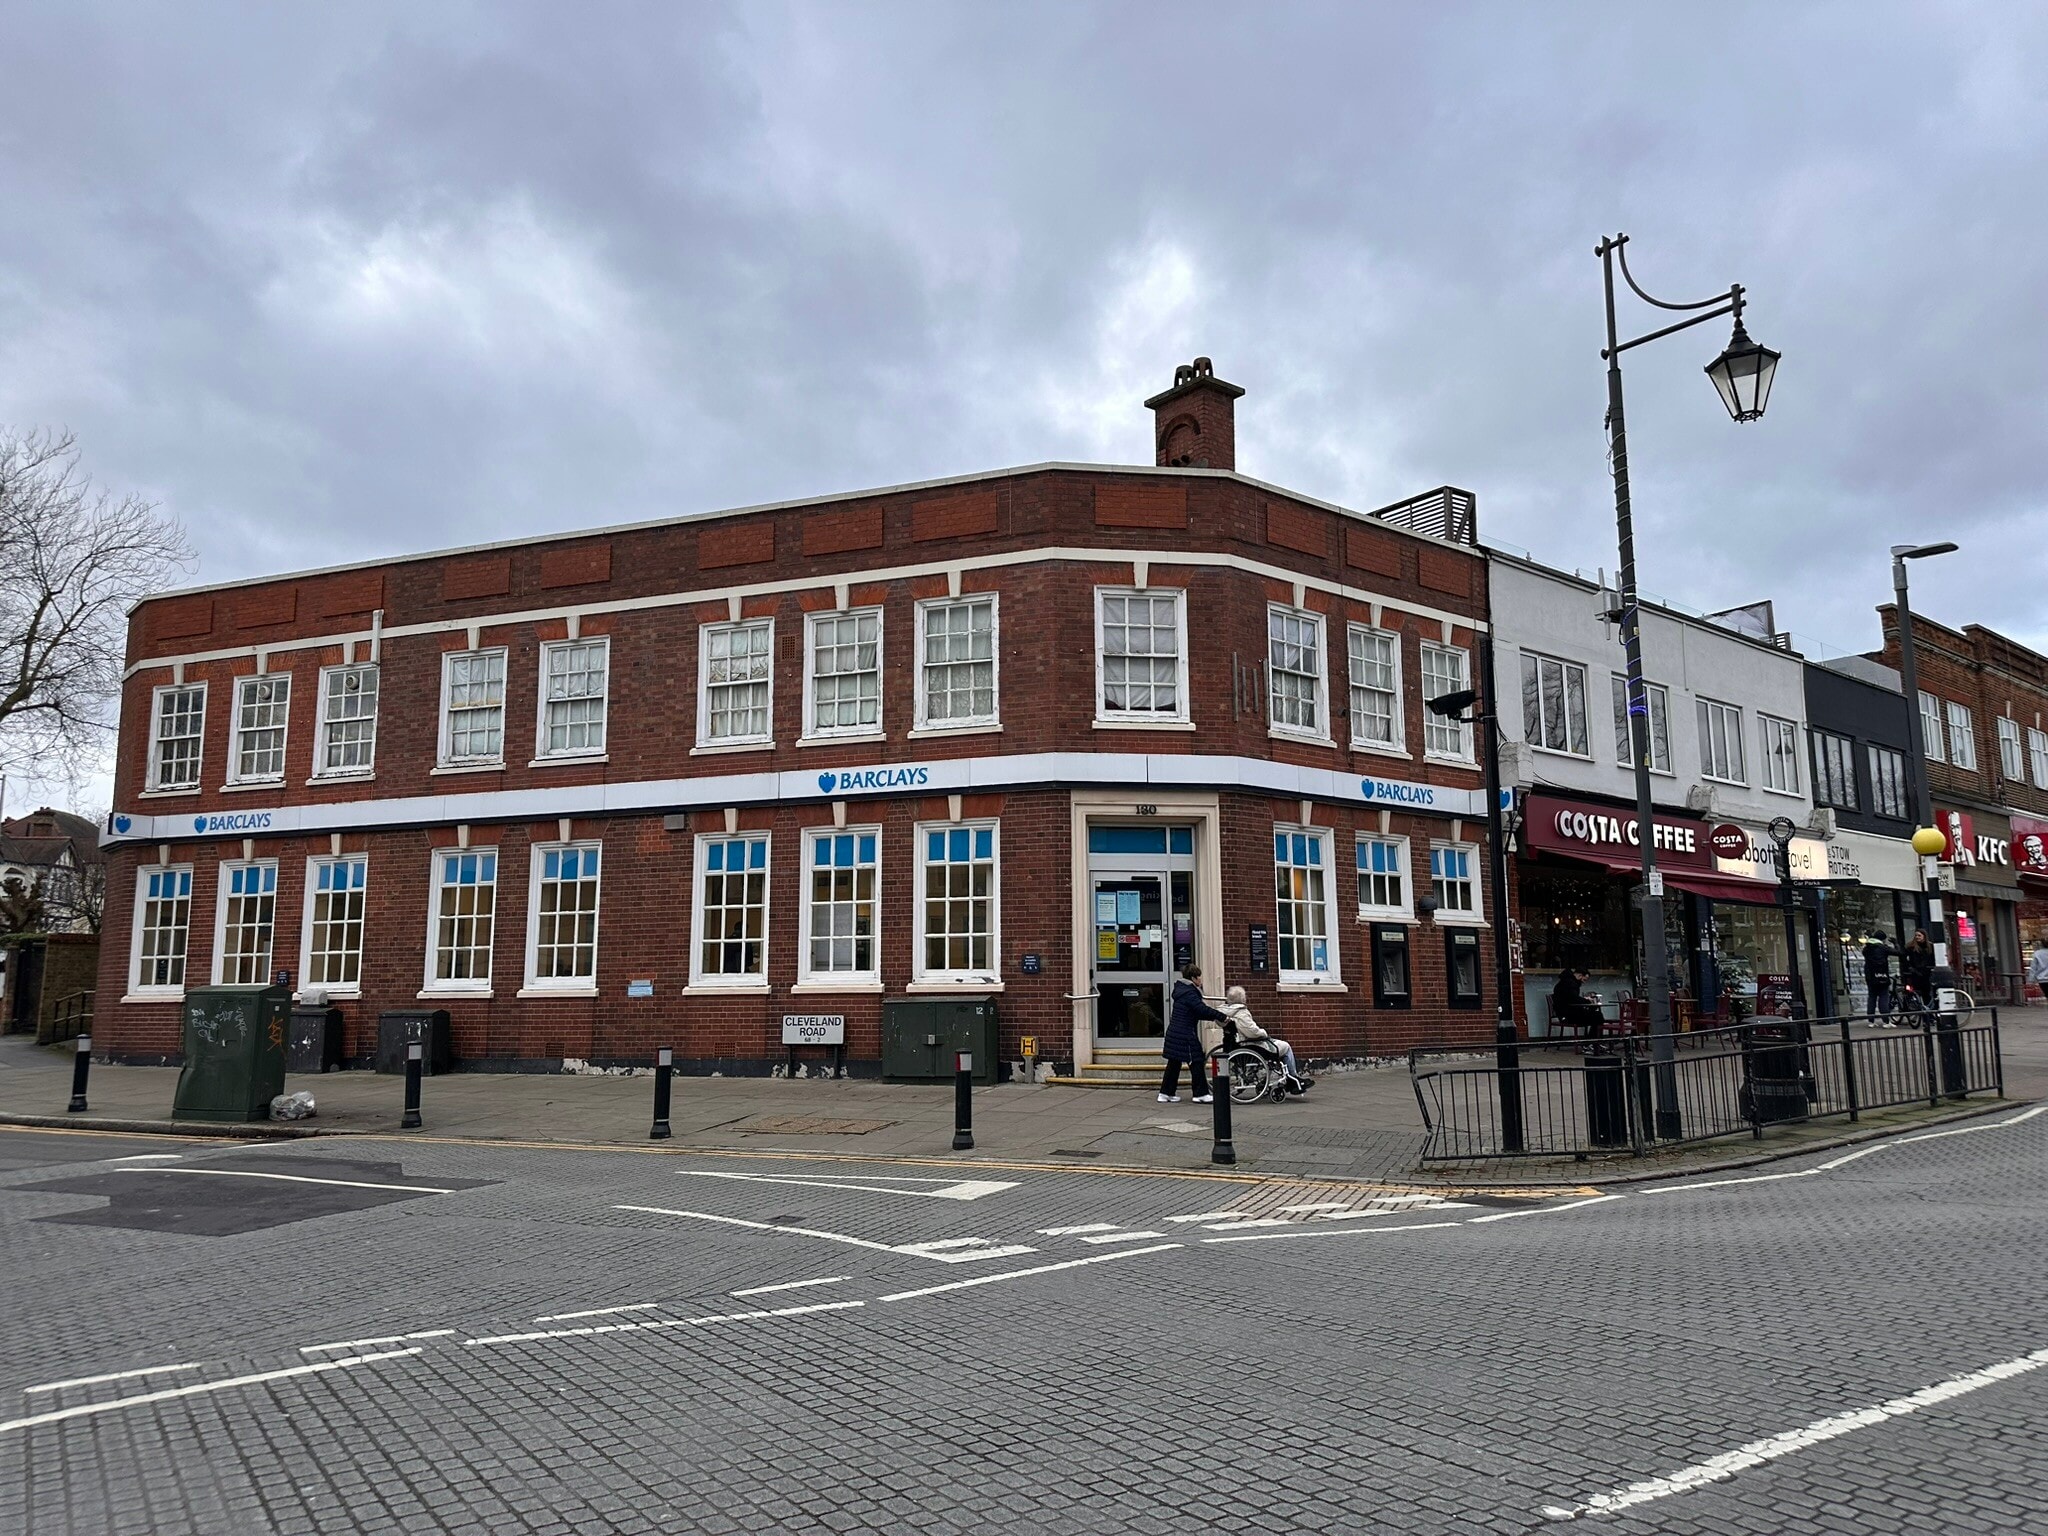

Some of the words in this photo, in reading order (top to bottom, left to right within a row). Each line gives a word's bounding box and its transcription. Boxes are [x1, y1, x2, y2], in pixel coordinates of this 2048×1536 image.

[840, 767, 928, 790] BARCLAYS
[1377, 782, 1434, 805] BARCLAYS
[209, 813, 271, 831] BARCLAYS
[1556, 810, 1622, 844] COSTA
[1622, 820, 1696, 852] CFFEE
[1713, 835, 1743, 844] COSTA
[1738, 838, 1779, 865] bbott
[1788, 846, 1813, 869] avel
[1831, 846, 1850, 861] STOW
[1977, 835, 2008, 866] KFC
[1828, 861, 1860, 878] ROTHERS
[975, 1006, 984, 1015] 12
[785, 1016, 842, 1027] CLEVELAND
[799, 1027, 827, 1037] ROAD
[1022, 1039, 1036, 1054] H
